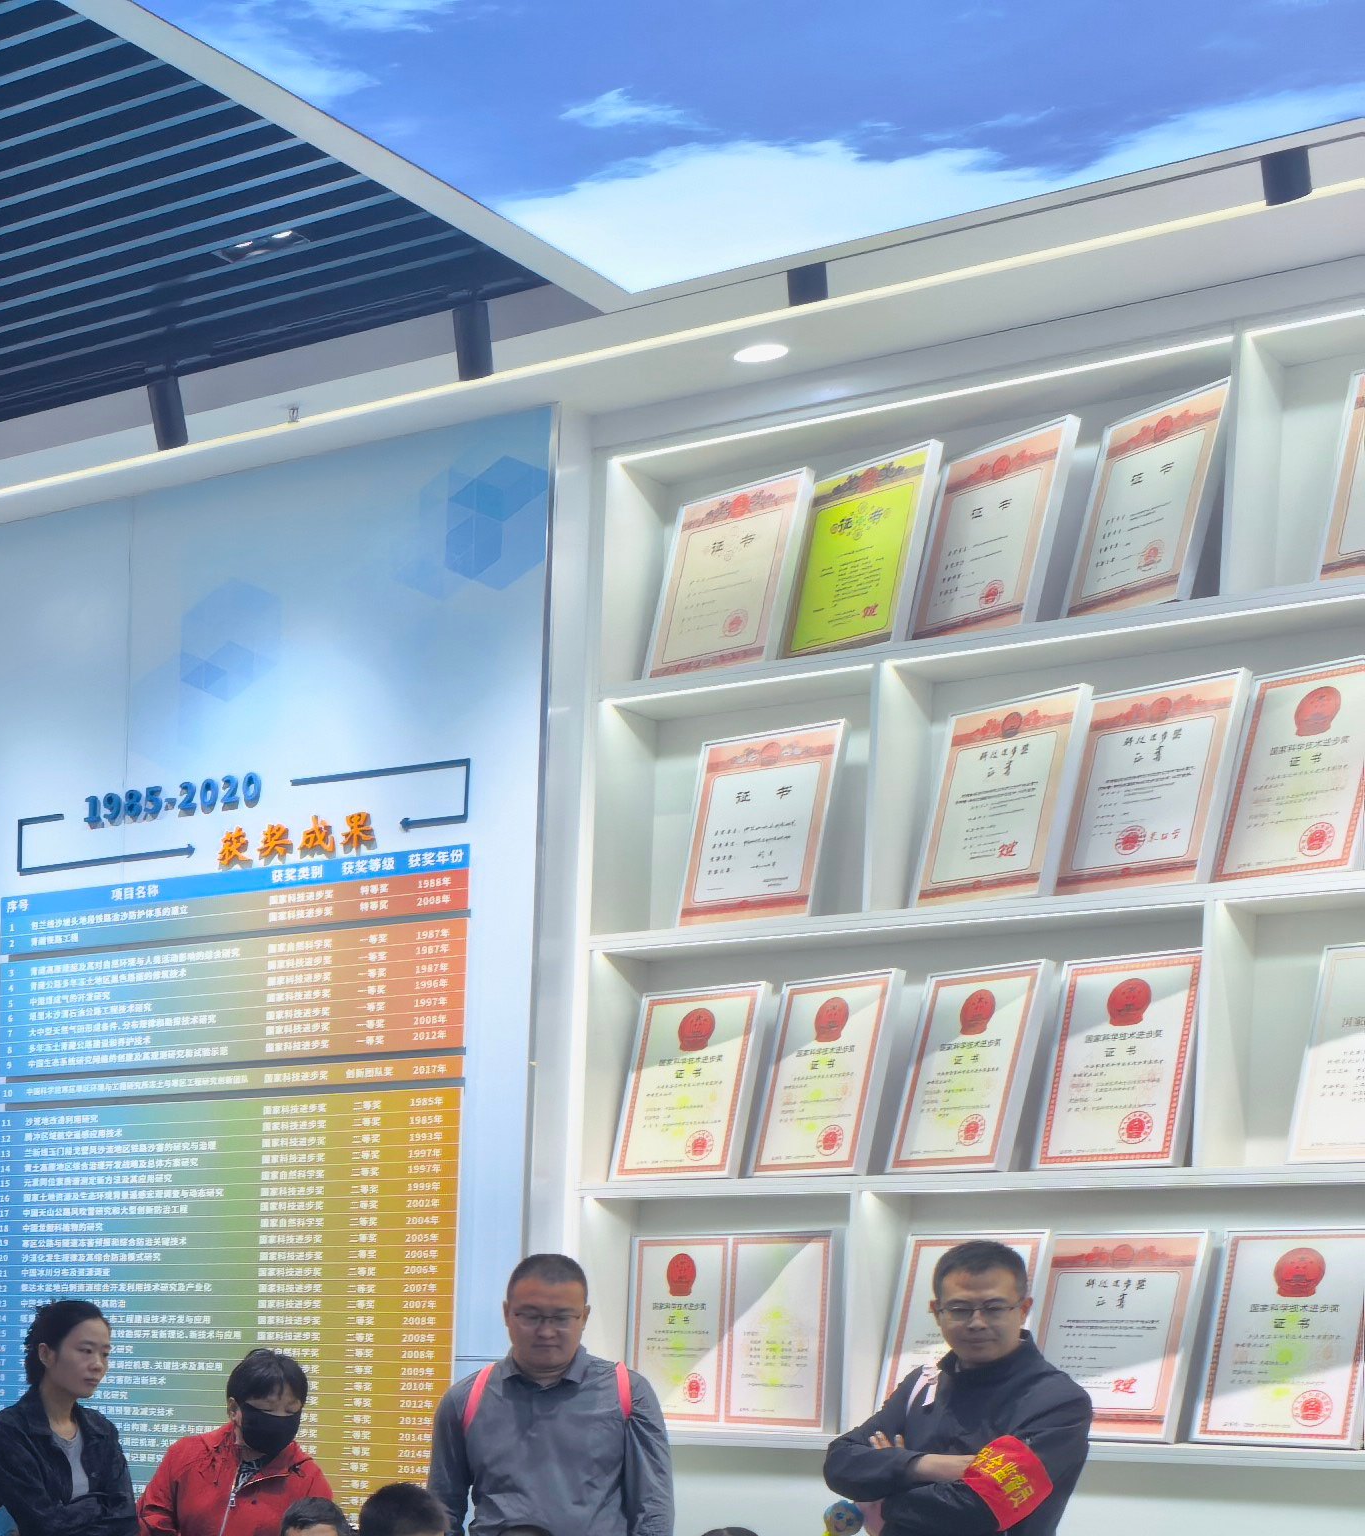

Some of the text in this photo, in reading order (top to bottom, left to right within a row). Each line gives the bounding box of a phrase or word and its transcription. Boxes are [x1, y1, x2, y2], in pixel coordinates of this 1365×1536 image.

[83, 772, 262, 827] 1985-2020
[216, 811, 375, 866] 获奖成果
[6, 849, 464, 913] 序号 项目名称 获奖类别 获奖等级 获奖年份
[972, 1446, 1036, 1509] 安全监督员
